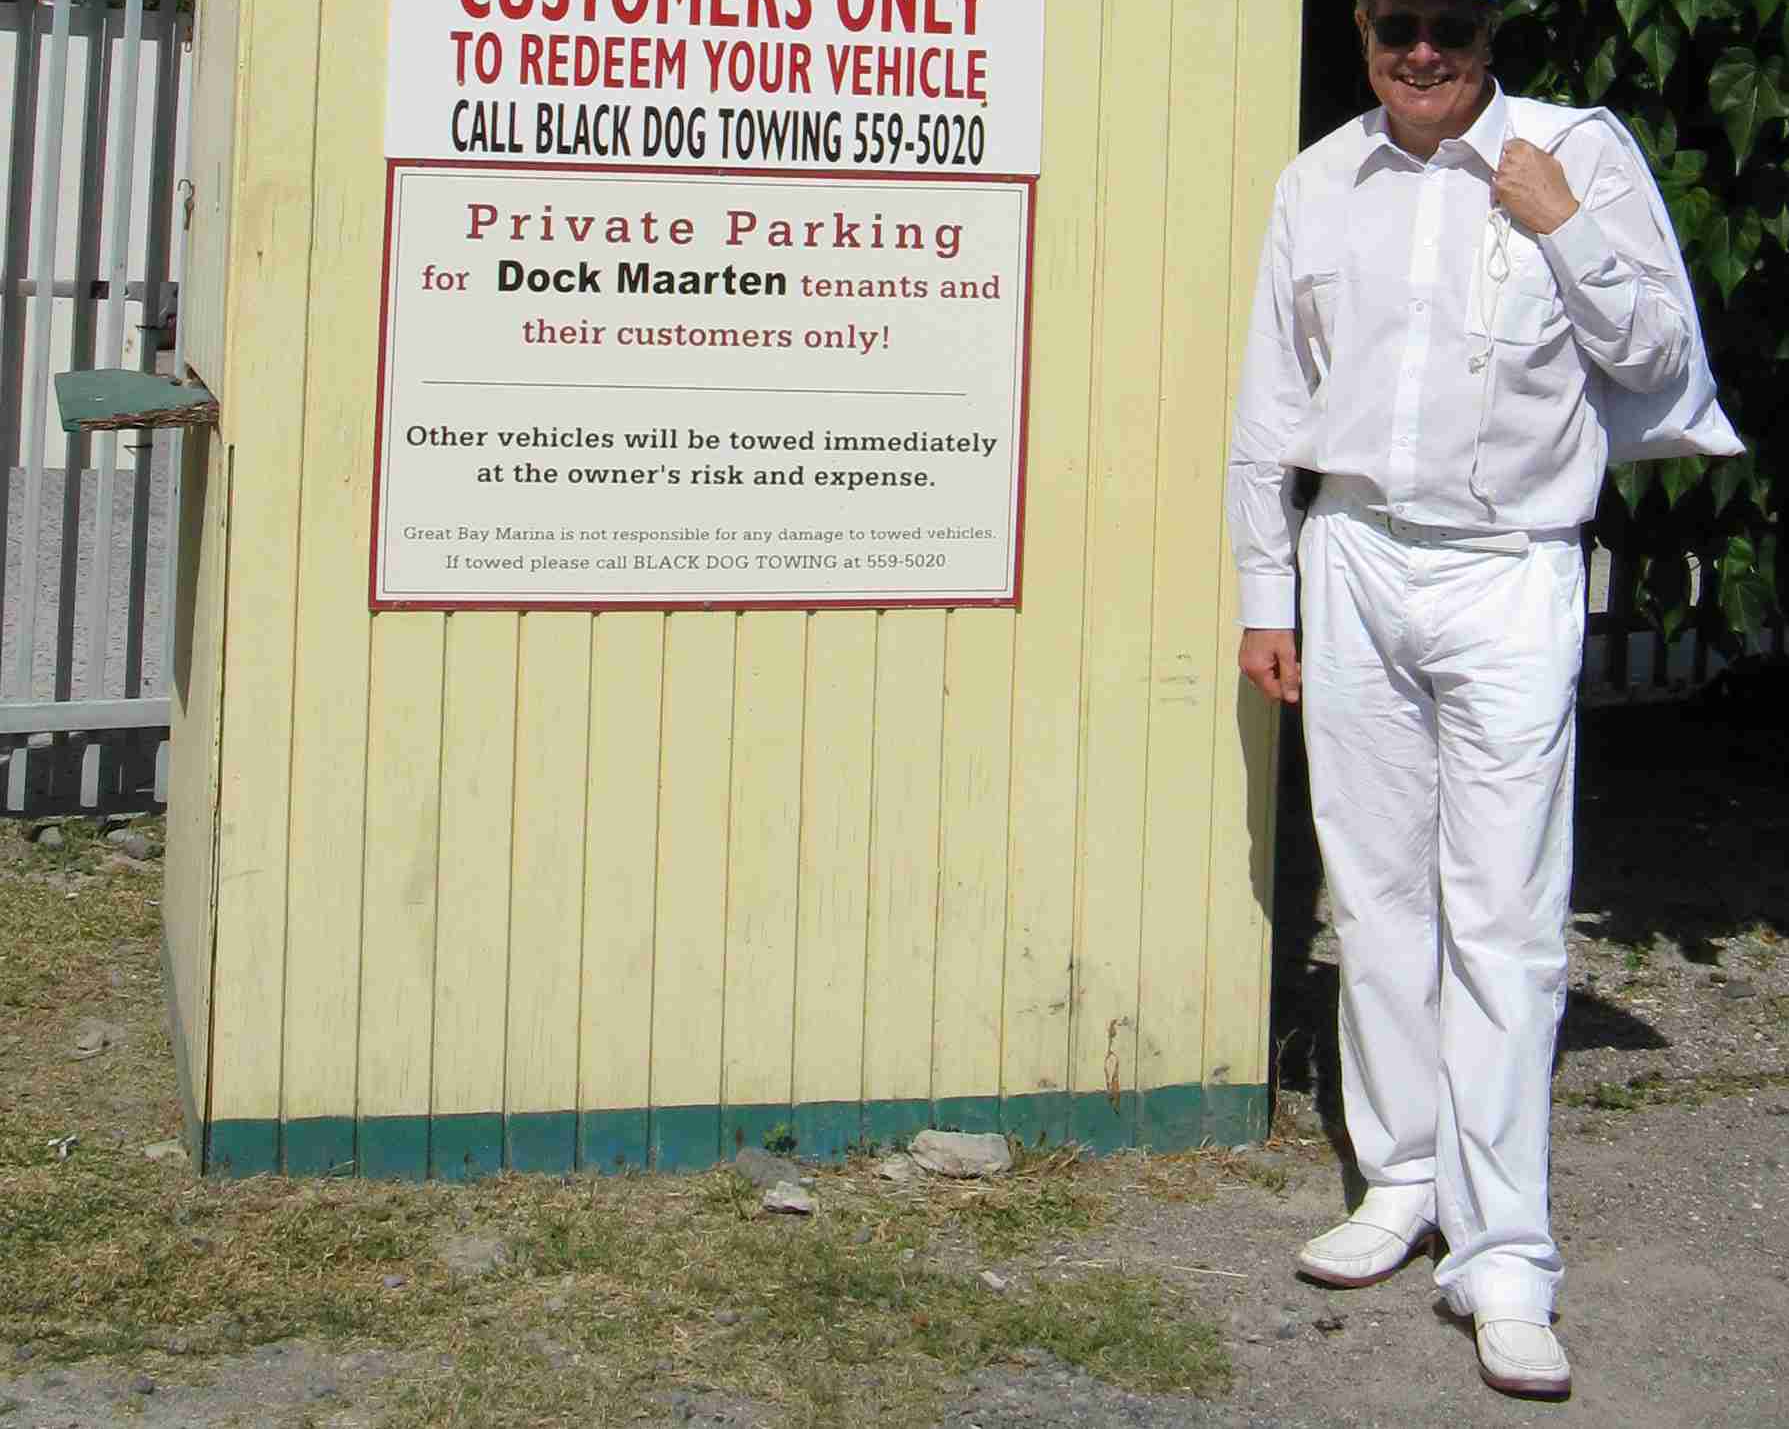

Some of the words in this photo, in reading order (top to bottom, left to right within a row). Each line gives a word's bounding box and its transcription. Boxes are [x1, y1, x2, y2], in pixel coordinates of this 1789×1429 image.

[450, 31, 501, 84] TO
[520, 34, 686, 89] REDEEM
[702, 41, 811, 95] YOUR
[827, 45, 987, 99] VEHICLE
[451, 100, 522, 152] CALL
[536, 103, 631, 156] BLACK
[643, 106, 706, 159] DOG
[718, 108, 841, 162] TOWING
[853, 113, 984, 164] 559-5020
[466, 204, 695, 245] Private
[726, 211, 963, 258] Parking
[422, 266, 470, 292] for
[497, 260, 601, 294] Dock
[617, 262, 786, 295] Maarten
[801, 274, 928, 299] tenants
[940, 275, 999, 300] and
[523, 320, 606, 345] their
[617, 324, 792, 348] customers
[804, 325, 889, 355] only!
[406, 426, 488, 449] Other
[498, 428, 614, 449] vehicles
[624, 429, 678, 450] will
[688, 429, 720, 451] be
[730, 430, 814, 452] towed
[824, 431, 998, 457] immediately
[478, 464, 504, 484] at
[513, 463, 557, 484] the
[568, 463, 680, 485] owner's
[690, 466, 743, 486] risk
[754, 466, 804, 487] and
[814, 467, 936, 490] expense.
[404, 526, 452, 540] Great
[457, 526, 490, 544] Bay
[496, 526, 555, 541] Marina
[560, 526, 574, 541] is
[580, 527, 608, 541] not
[612, 526, 709, 544] responsible
[714, 527, 738, 541] for
[743, 530, 773, 544] any
[778, 527, 843, 544] damage
[848, 528, 865, 540] to
[870, 526, 921, 540] towed
[927, 525, 997, 540] vehicles.
[446, 554, 460, 569] If
[464, 555, 524, 569] towed
[531, 554, 591, 572] please
[596, 555, 627, 569] call
[633, 555, 700, 569] BLACK
[706, 555, 749, 570] DOG
[755, 554, 837, 569] TOWING
[843, 555, 861, 569] at
[867, 554, 946, 569] 559-5020
